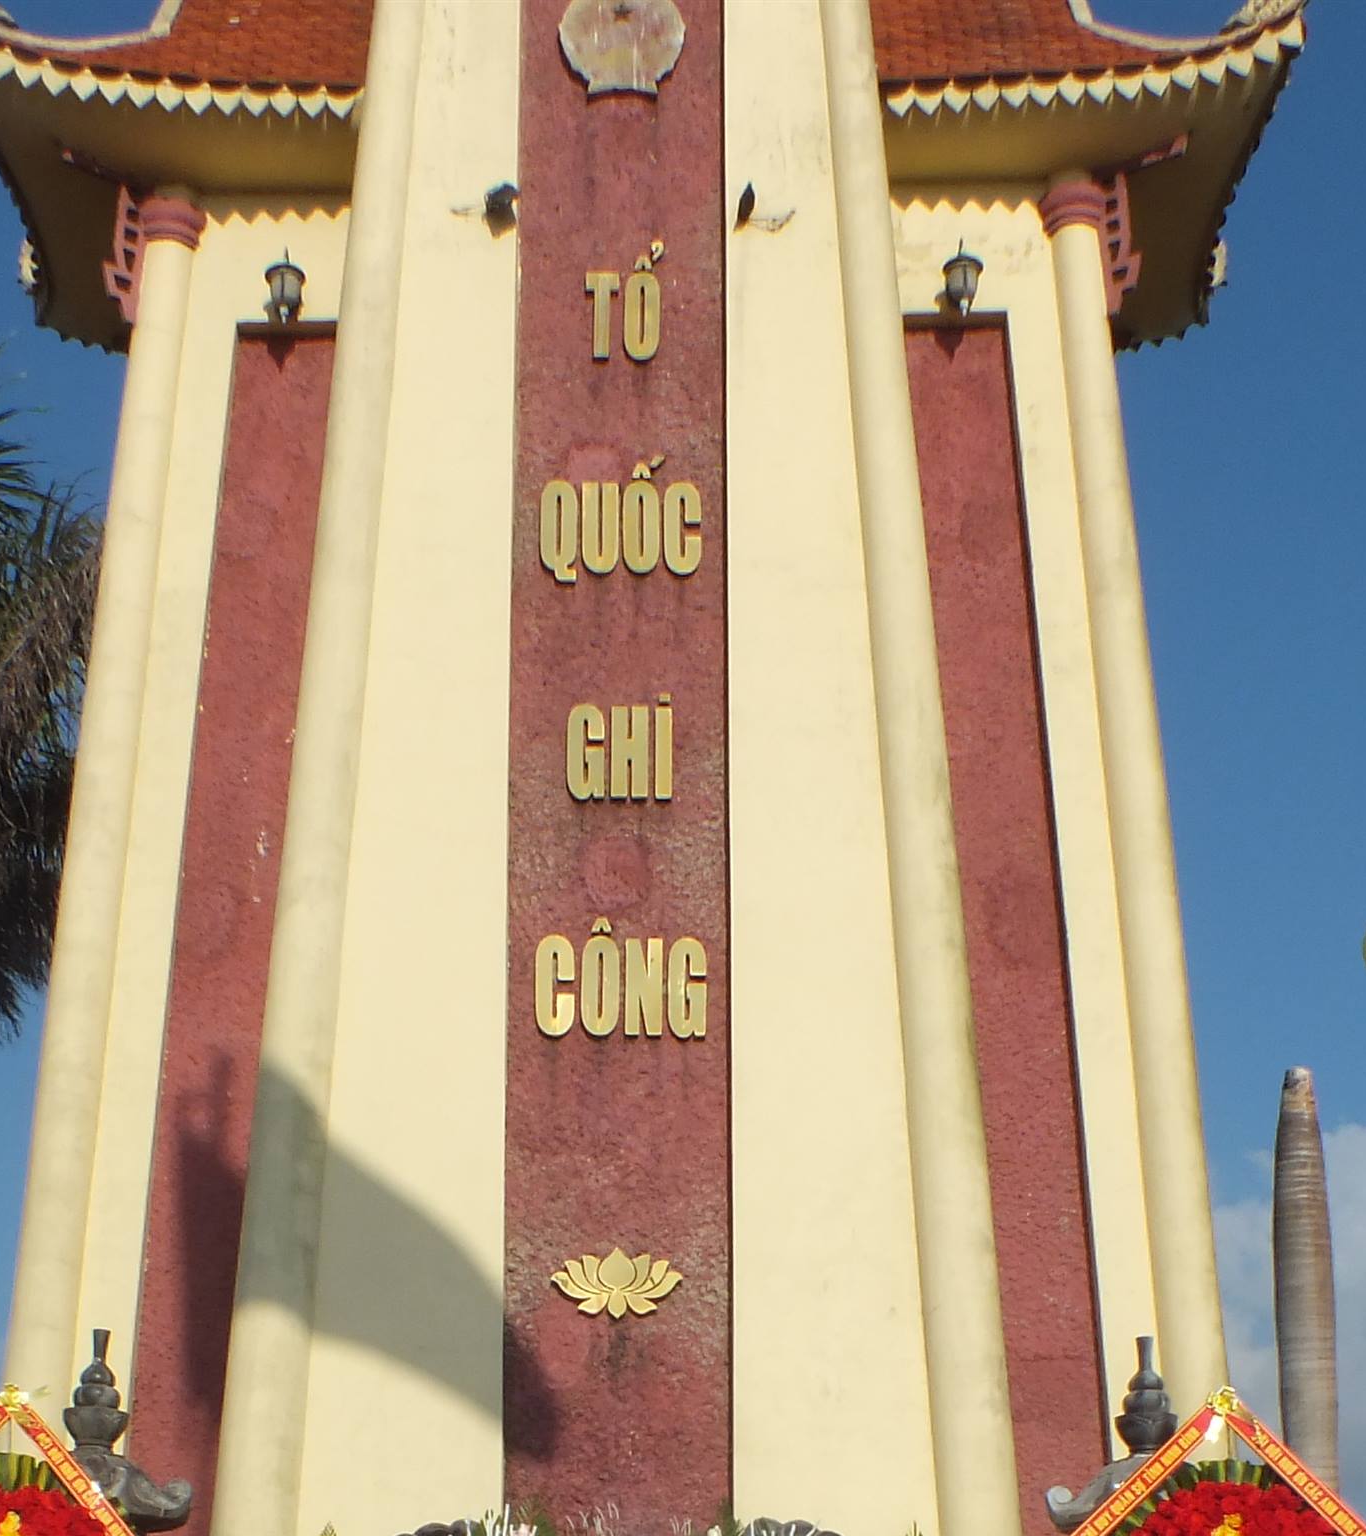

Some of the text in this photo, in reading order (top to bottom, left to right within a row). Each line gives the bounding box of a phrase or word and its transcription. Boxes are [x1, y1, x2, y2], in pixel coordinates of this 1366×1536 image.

[585, 240, 664, 361] TỔ
[540, 455, 702, 583] QUỐC
[535, 917, 707, 1039] CÔNG
